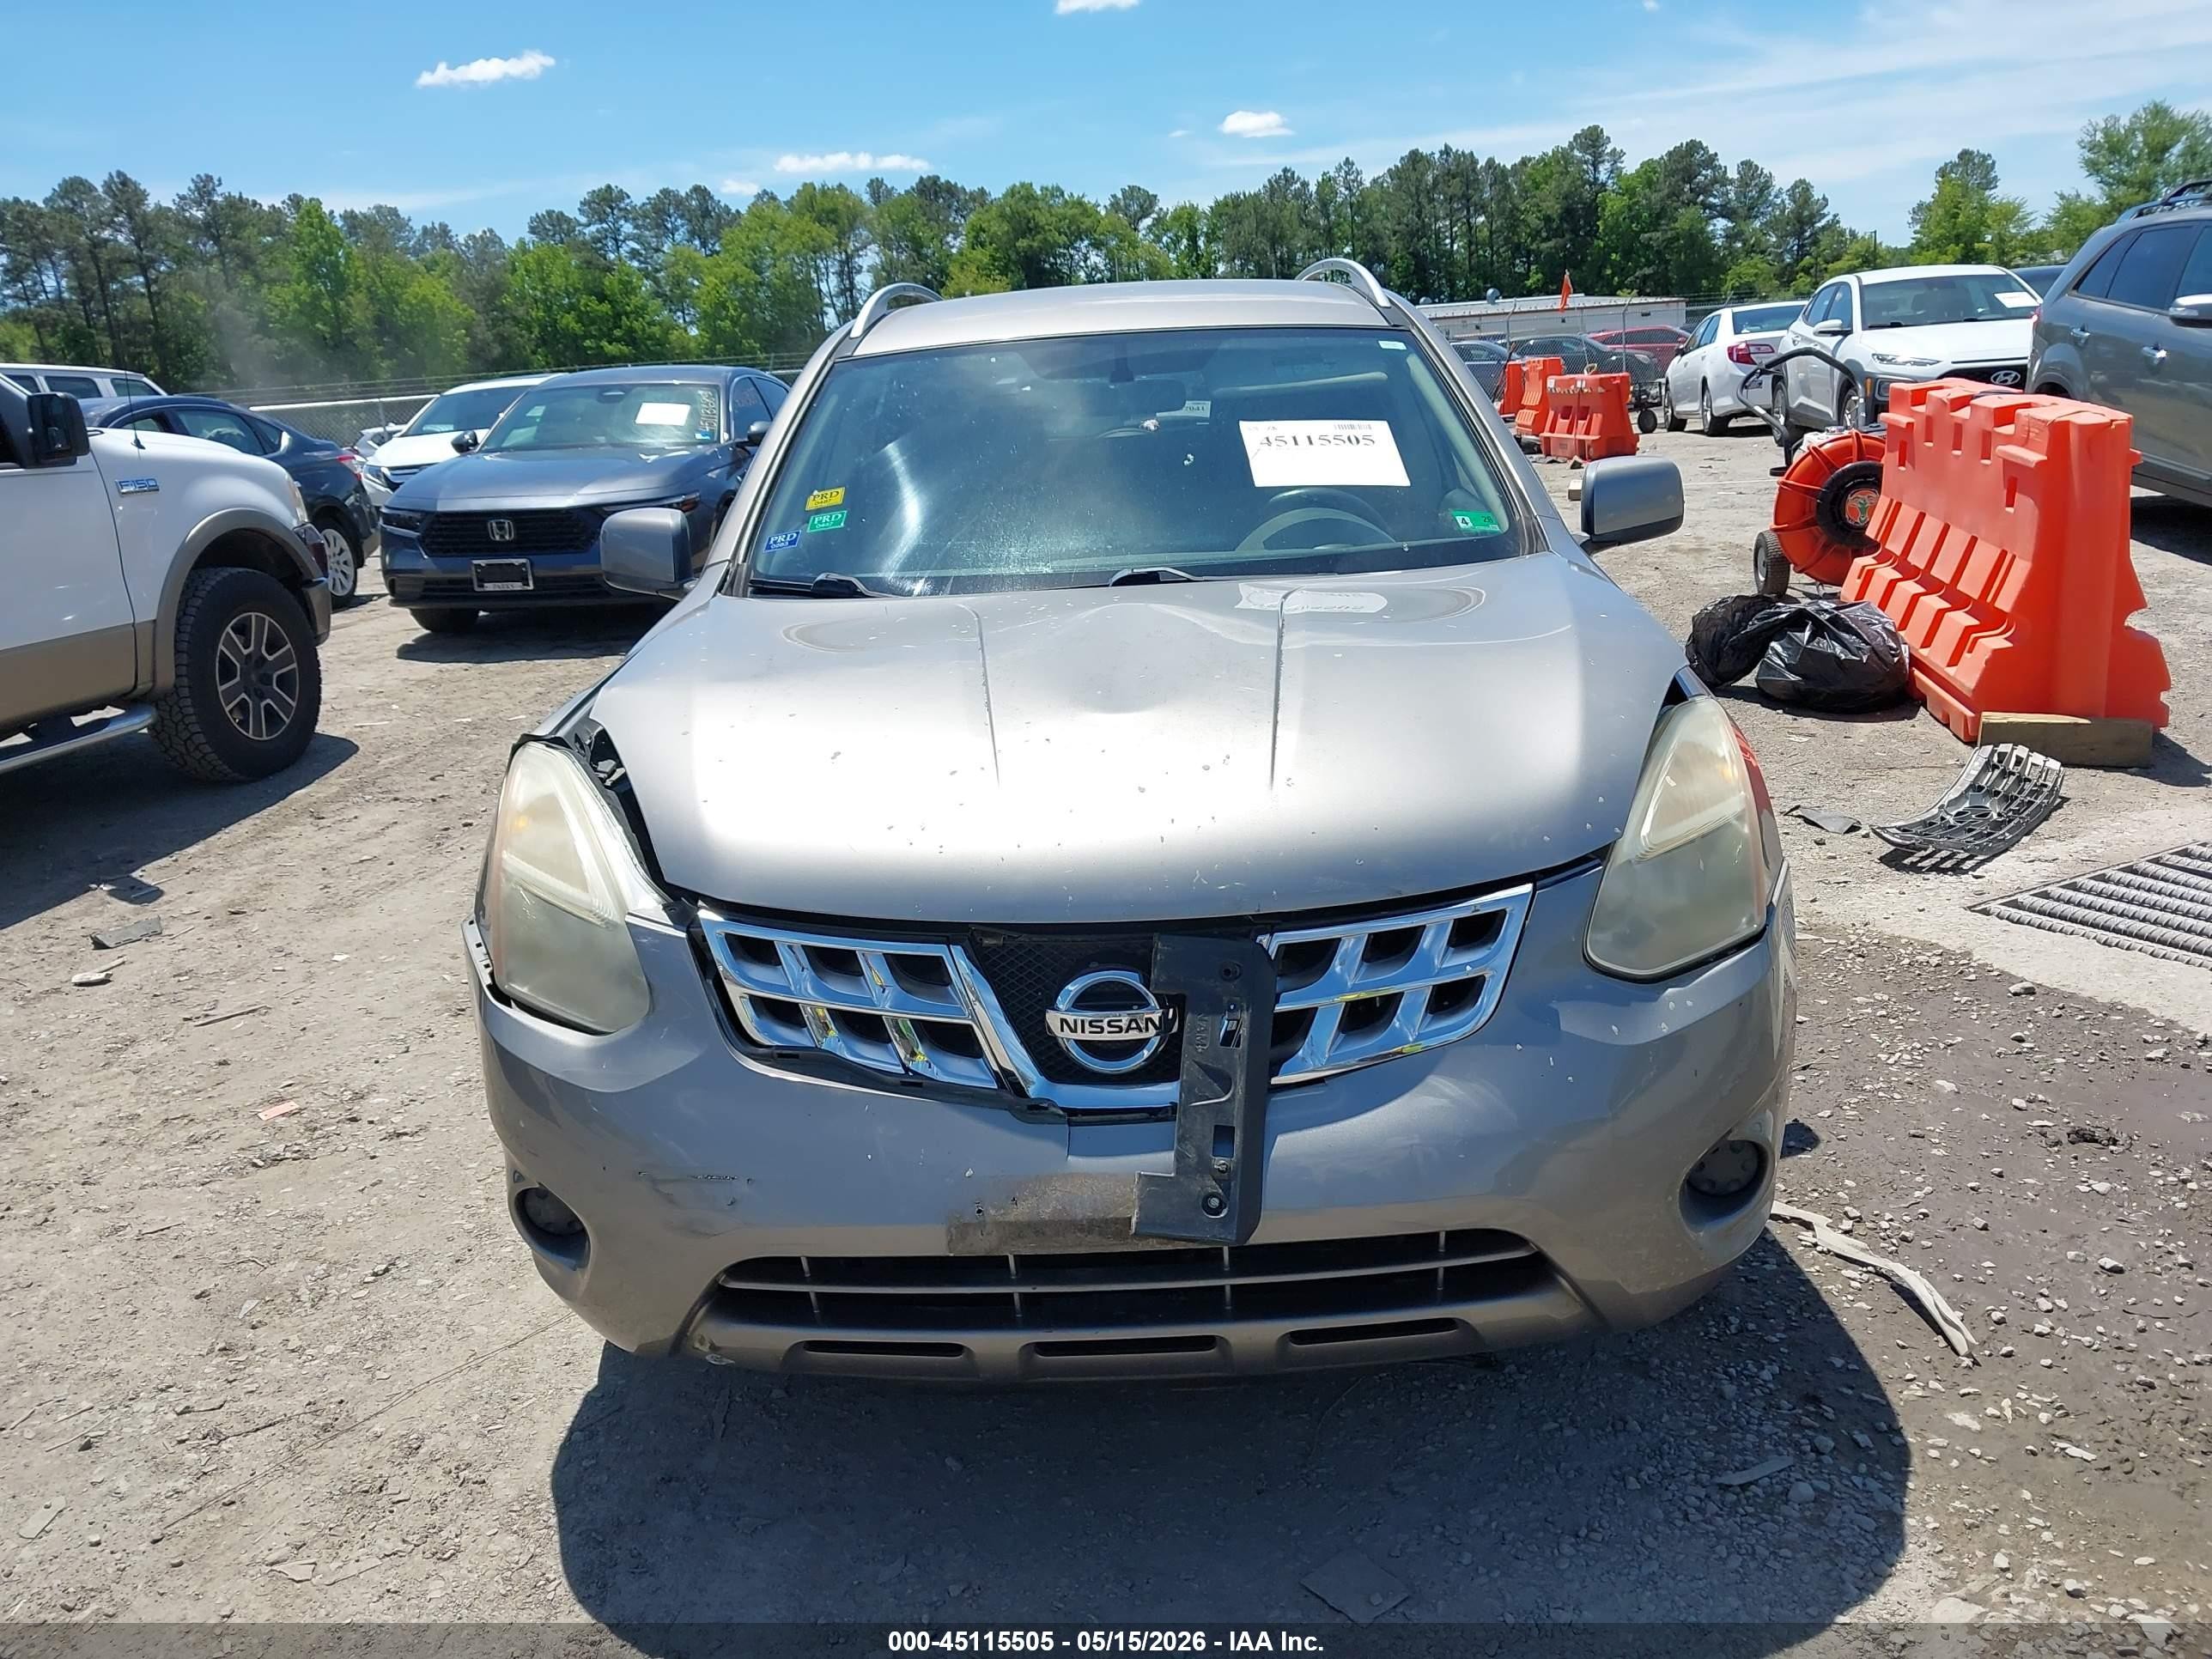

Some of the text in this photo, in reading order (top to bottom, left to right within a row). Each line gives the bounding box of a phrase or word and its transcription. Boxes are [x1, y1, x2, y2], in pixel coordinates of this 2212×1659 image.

[1260, 434, 1376, 447] 45115505
[812, 490, 840, 502] PRD
[814, 514, 842, 525] PRD
[1461, 517, 1469, 526] 4
[769, 532, 797, 544] PRD
[1059, 1017, 1163, 1035] NISSAN
